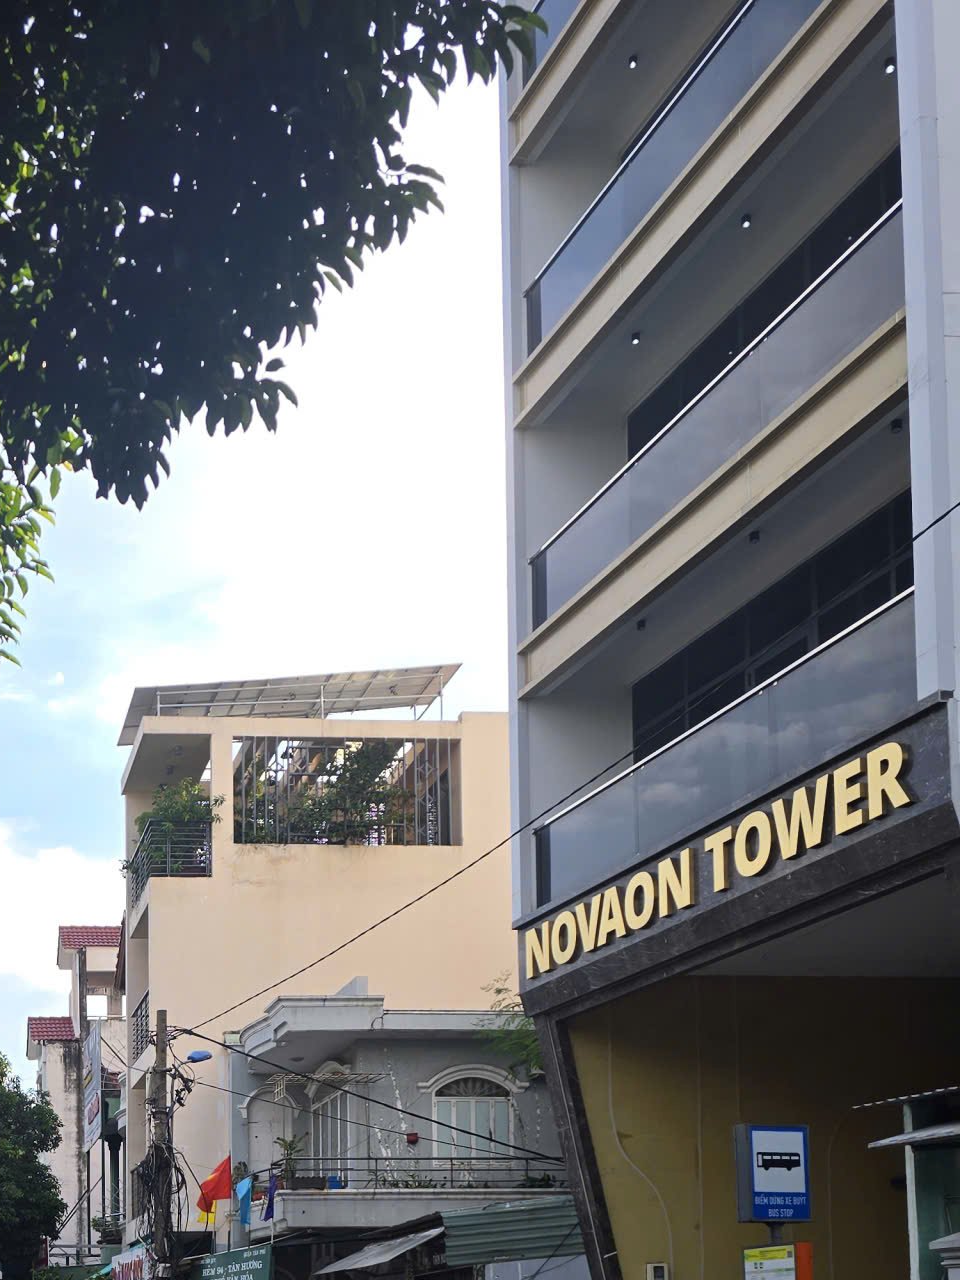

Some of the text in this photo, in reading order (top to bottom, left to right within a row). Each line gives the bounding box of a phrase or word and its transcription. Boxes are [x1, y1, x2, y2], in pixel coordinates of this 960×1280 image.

[525, 741, 911, 979] NOVAON TOWER
[785, 1196, 793, 1205] XE
[768, 1208, 794, 1217] BUS STOP
